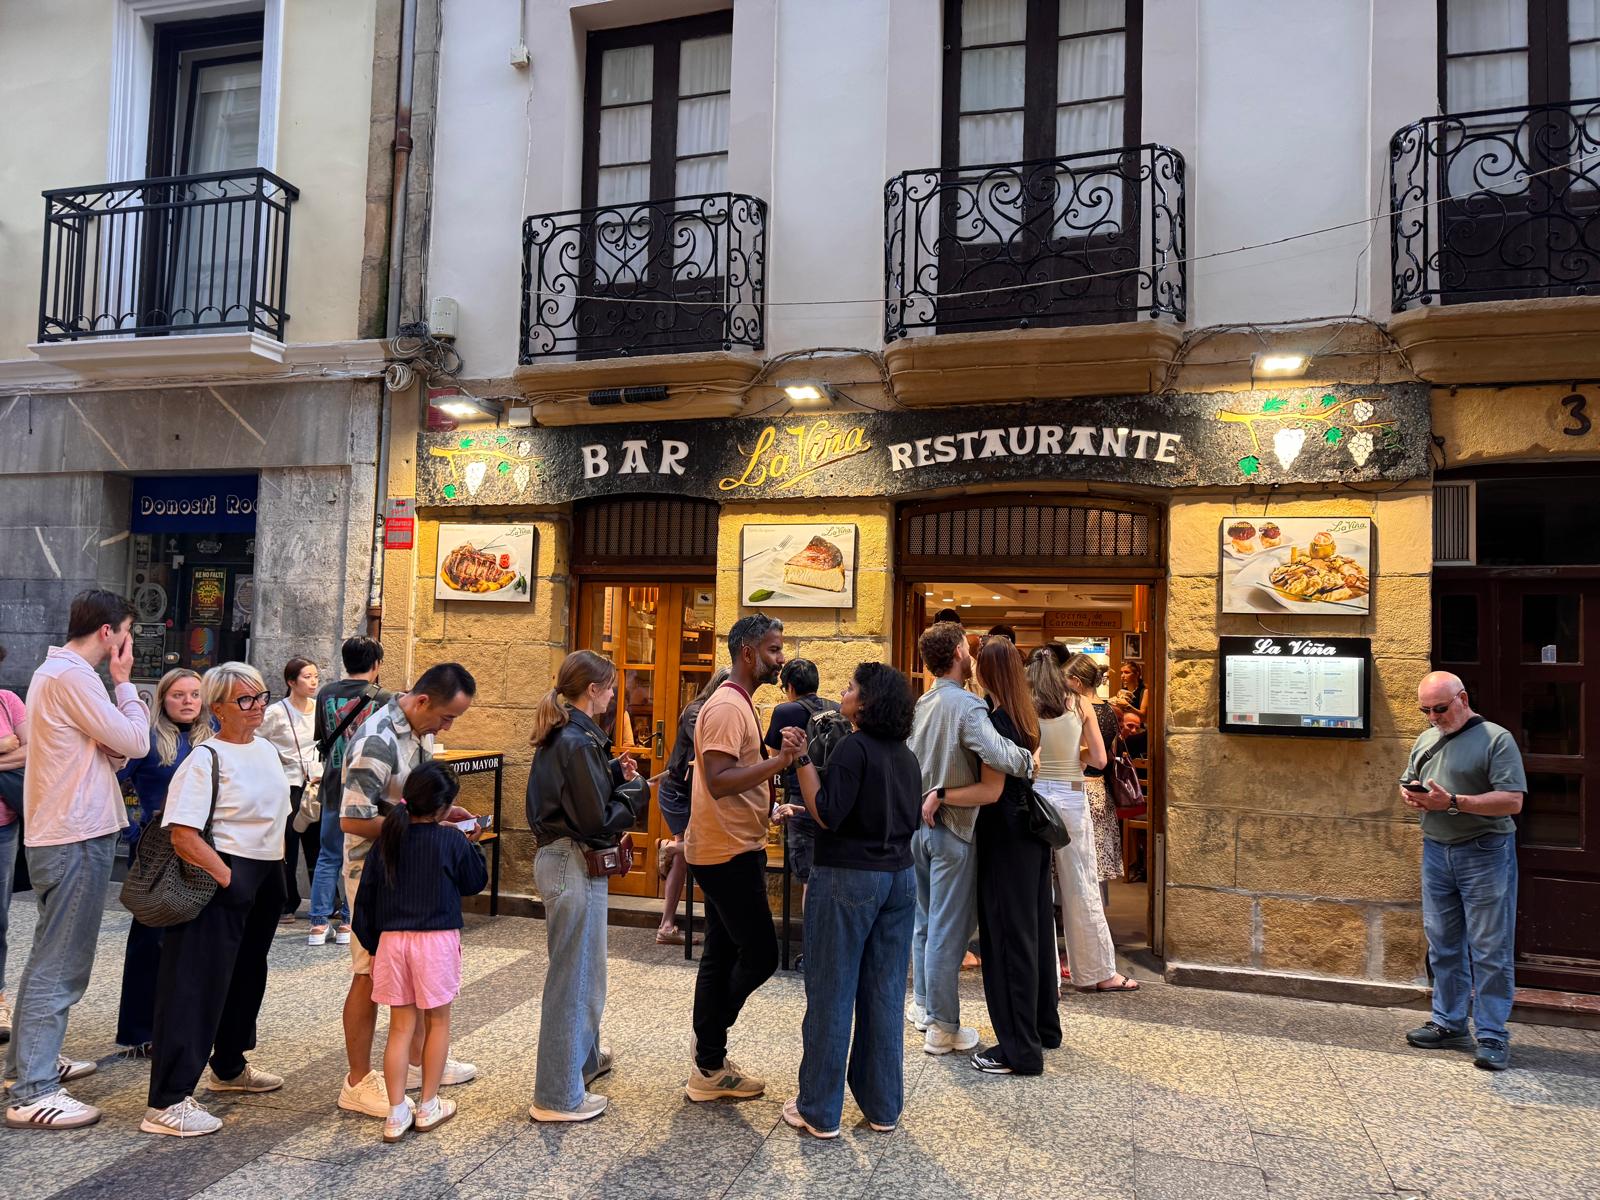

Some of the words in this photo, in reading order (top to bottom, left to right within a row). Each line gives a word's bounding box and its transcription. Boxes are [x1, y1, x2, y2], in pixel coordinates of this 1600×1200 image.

[1561, 394, 1592, 436] 3
[581, 439, 689, 479] BAR
[718, 426, 790, 491] La
[786, 419, 871, 469] Viña
[887, 425, 1181, 471] RESTAURANTE
[141, 495, 217, 515] Donosti
[209, 571, 224, 579] FALTE
[1252, 638, 1282, 655] La
[1288, 640, 1337, 656] Viña
[472, 757, 499, 771] MAYOR
